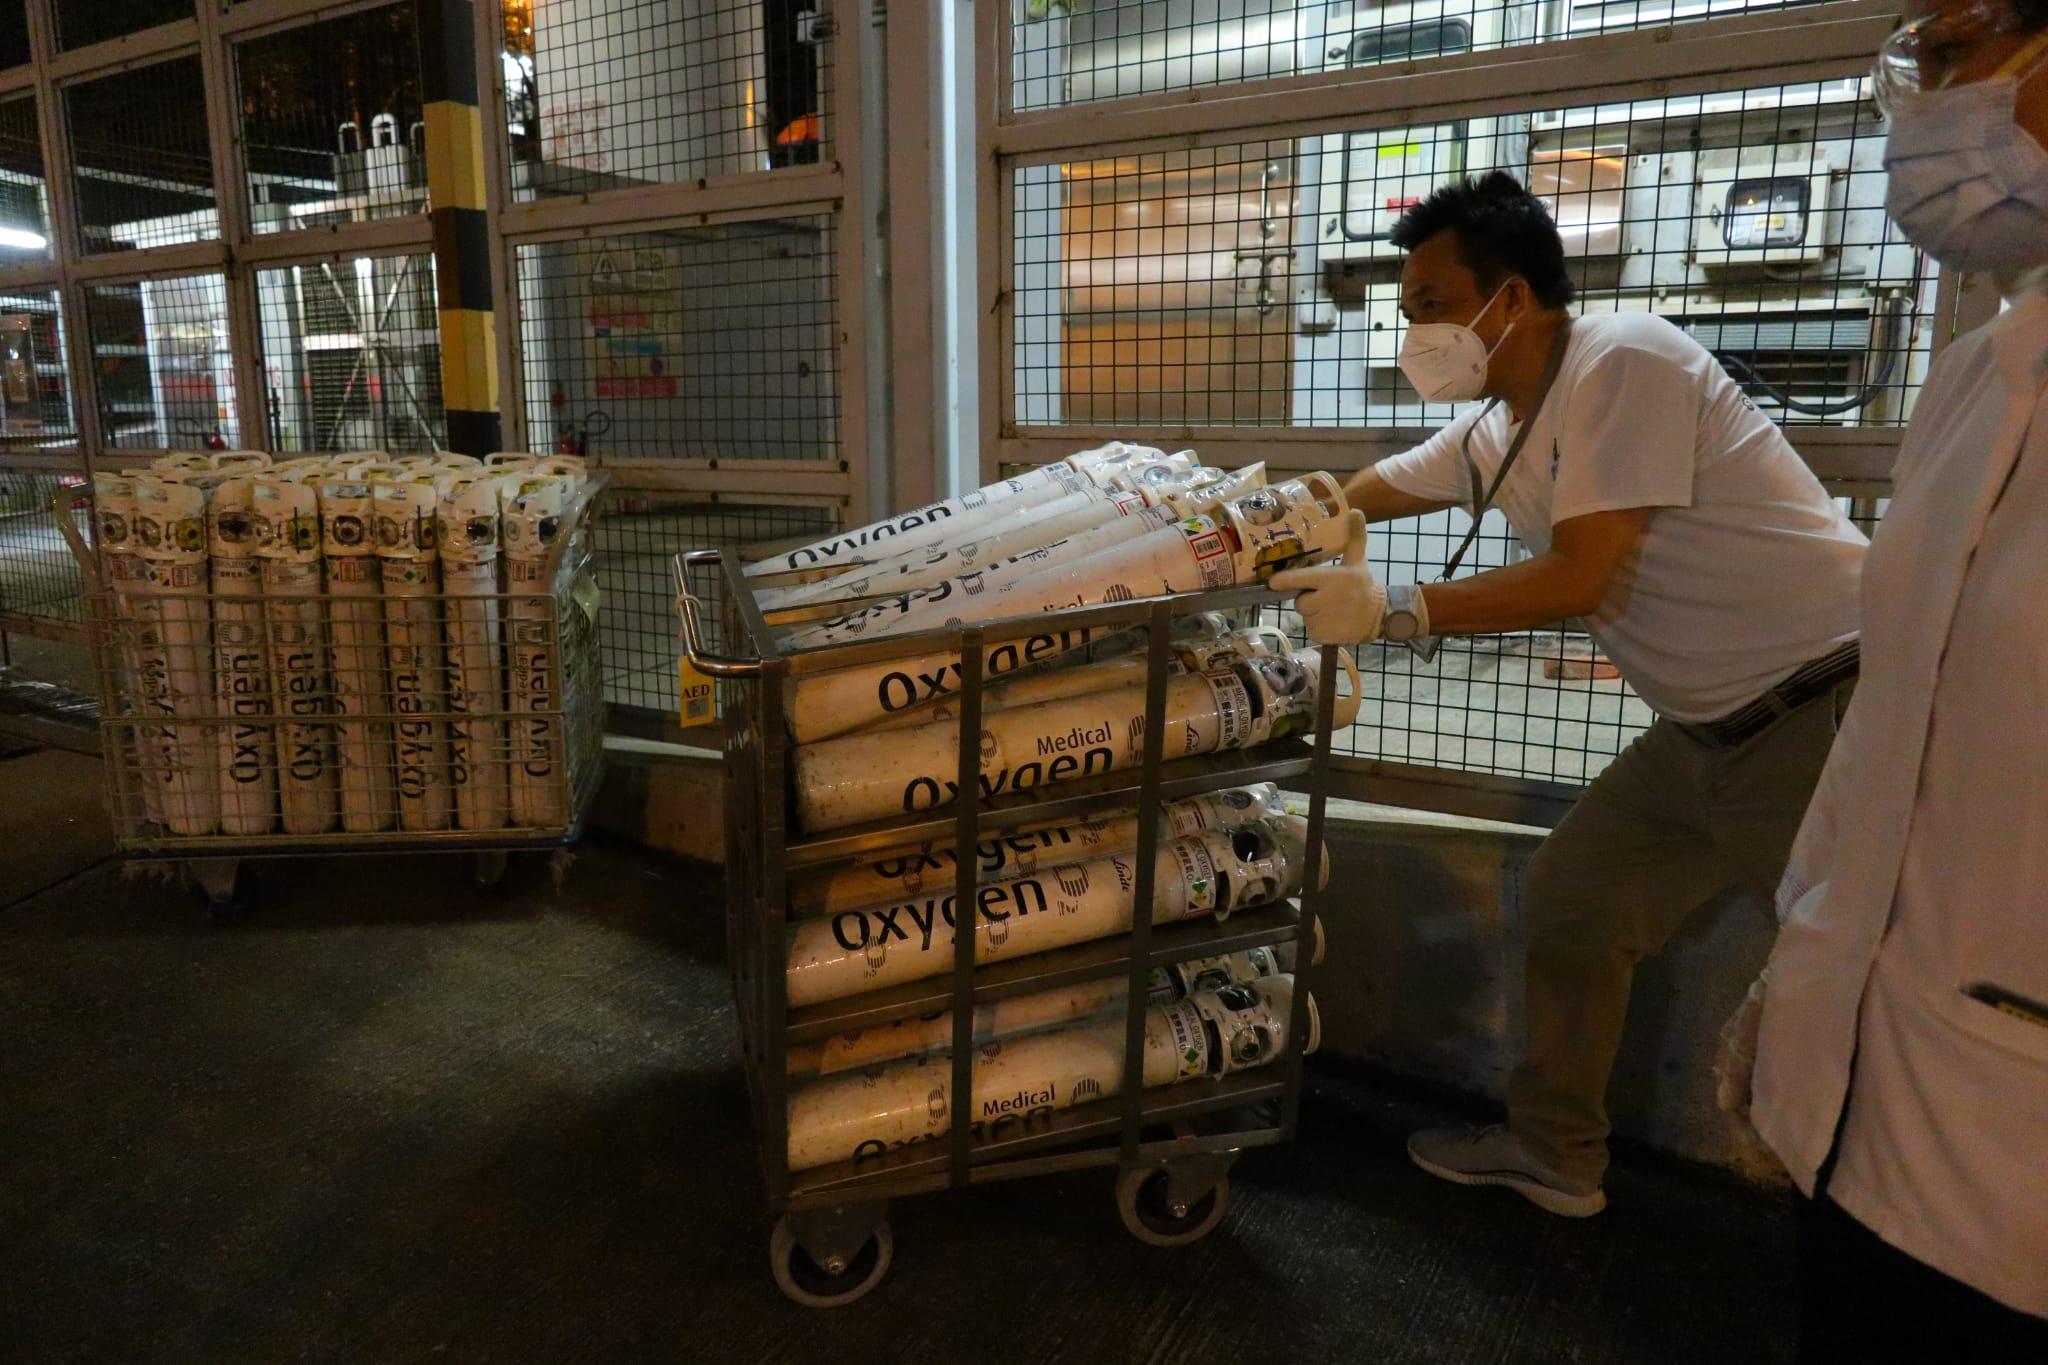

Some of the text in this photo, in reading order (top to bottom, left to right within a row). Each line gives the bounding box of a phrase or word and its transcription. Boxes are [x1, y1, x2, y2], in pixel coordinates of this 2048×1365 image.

[683, 684, 710, 699] AED
[878, 626, 1092, 713] Oxgen
[229, 653, 273, 784] Oxygen
[287, 652, 327, 781] Oxygen
[1037, 721, 1113, 756] Medical
[874, 827, 1072, 879] Oxgen
[1111, 856, 1133, 895] Linde
[983, 1084, 1056, 1118] Medical
